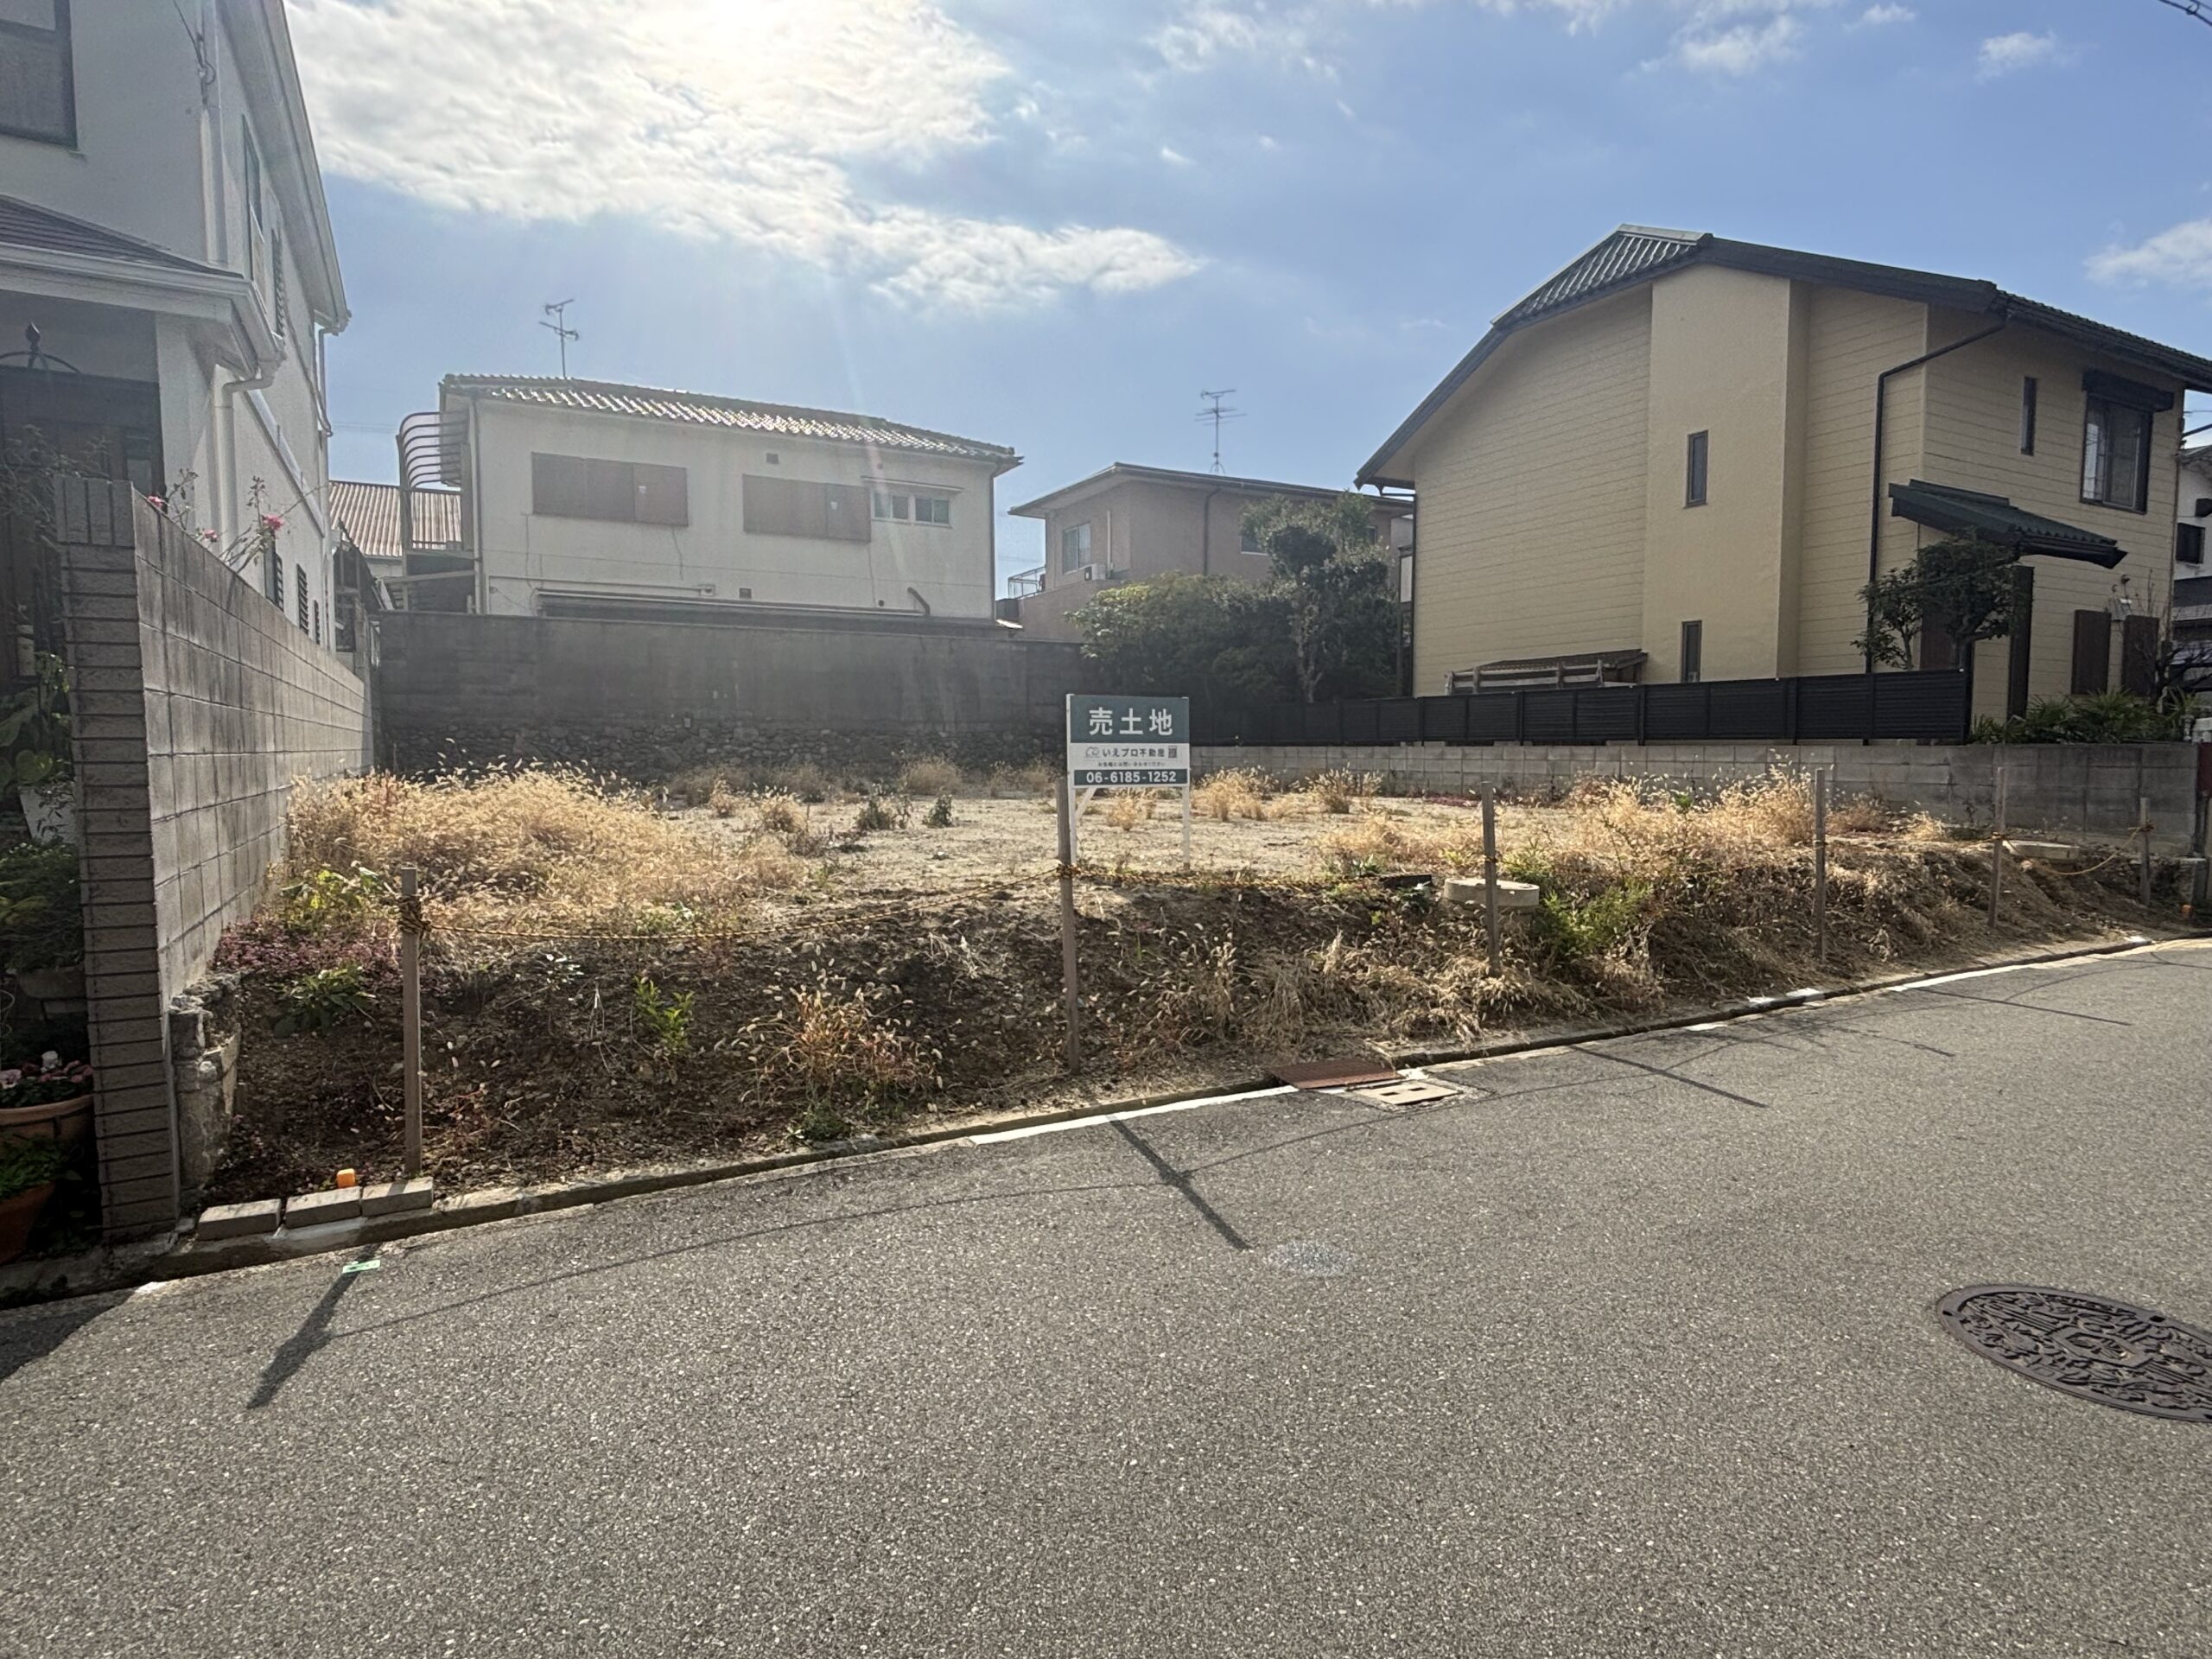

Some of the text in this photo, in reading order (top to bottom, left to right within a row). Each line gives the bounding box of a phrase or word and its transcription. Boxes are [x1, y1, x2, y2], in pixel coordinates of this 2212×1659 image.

[1089, 707, 1173, 736] 売土地
[1103, 747, 1165, 758] いえプロ不動産
[1086, 772, 1177, 784] 06-6185-1252
